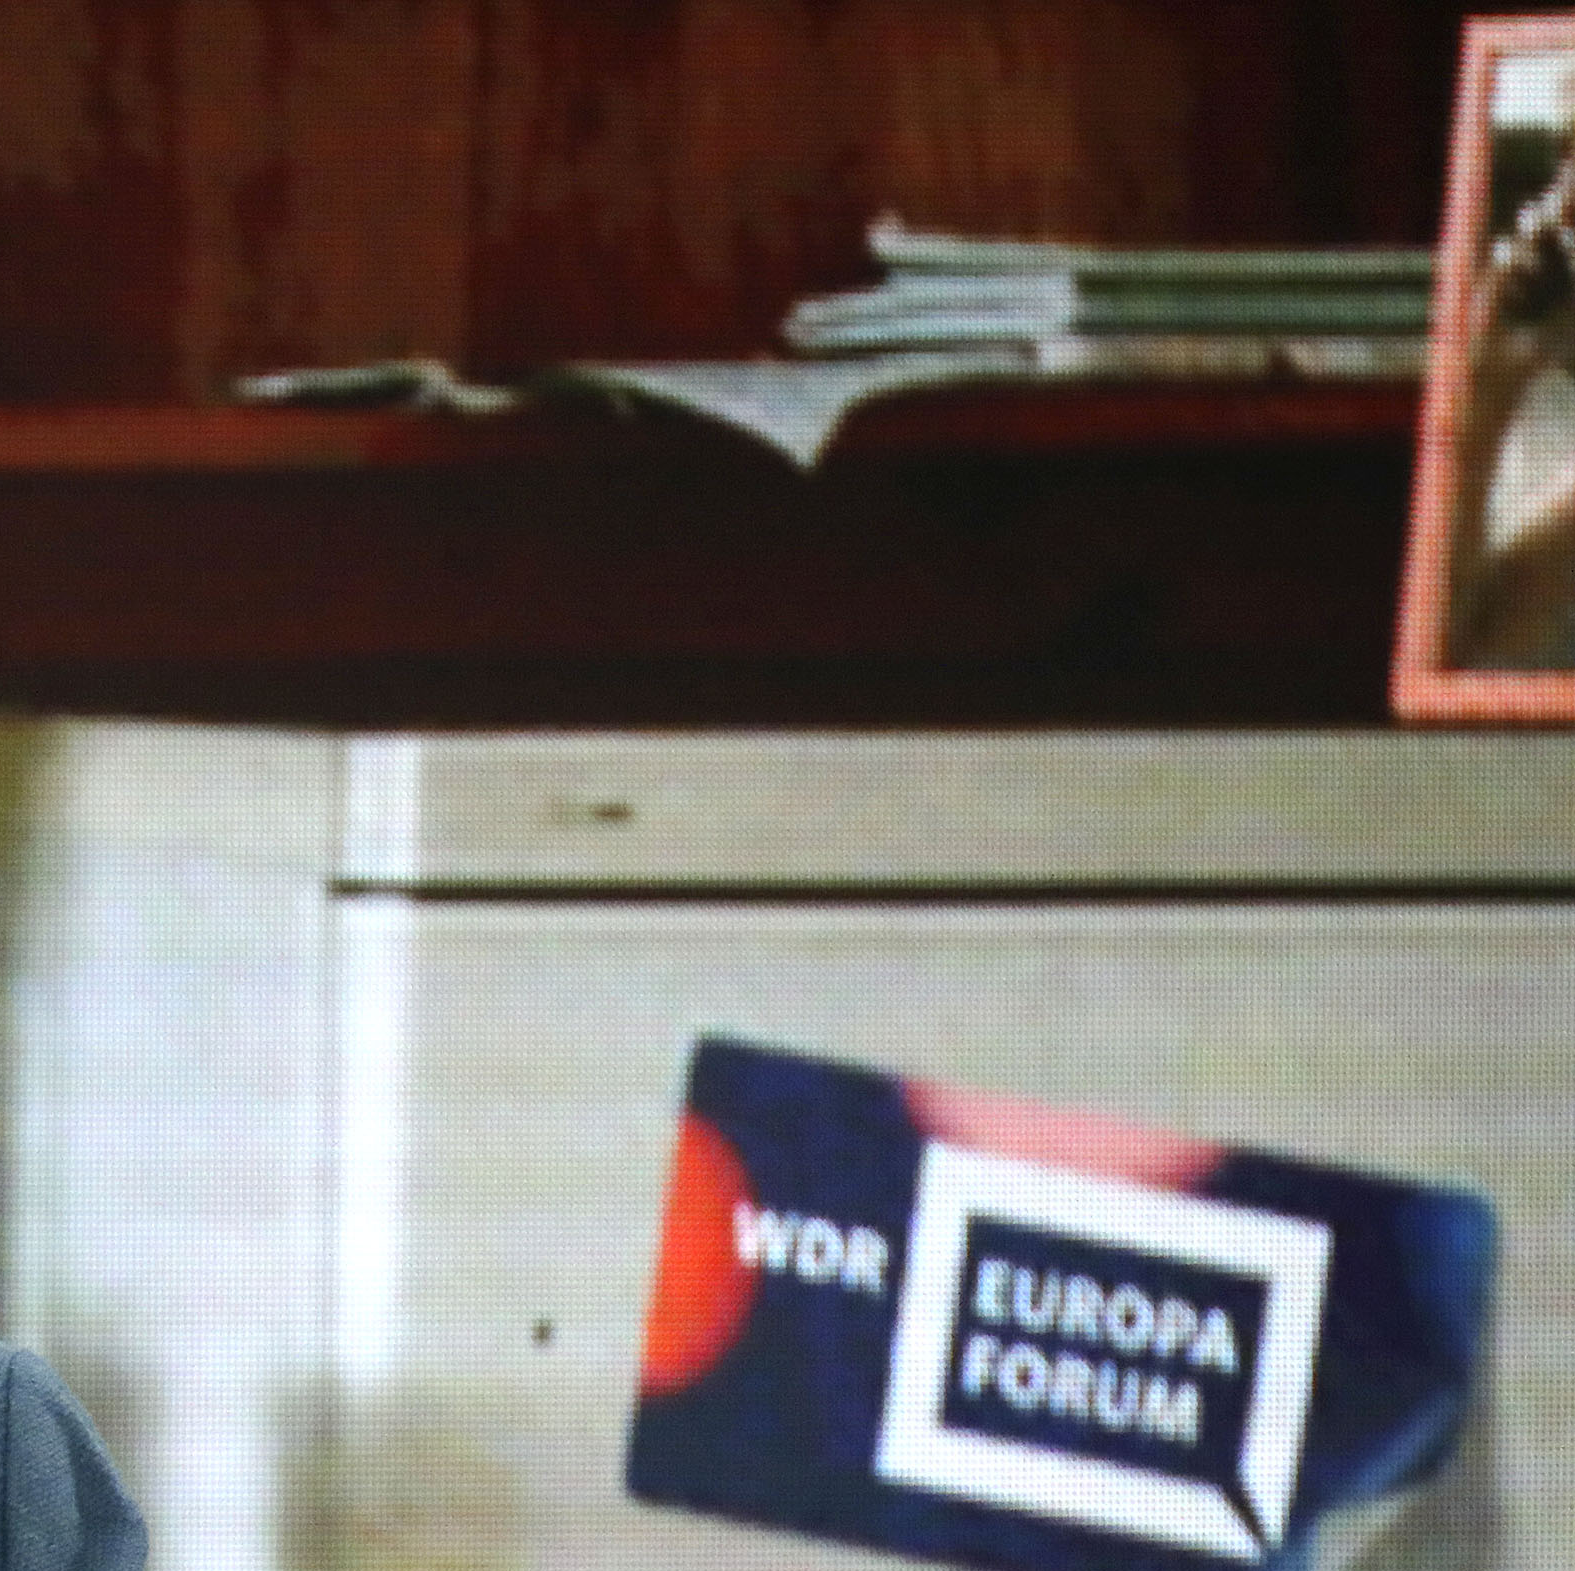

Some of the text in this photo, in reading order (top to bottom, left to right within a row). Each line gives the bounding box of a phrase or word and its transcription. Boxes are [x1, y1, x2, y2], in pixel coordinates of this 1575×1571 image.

[733, 1200, 890, 1296] WDR
[974, 1257, 1240, 1375] EUROPA
[960, 1332, 1202, 1445] FORUM
